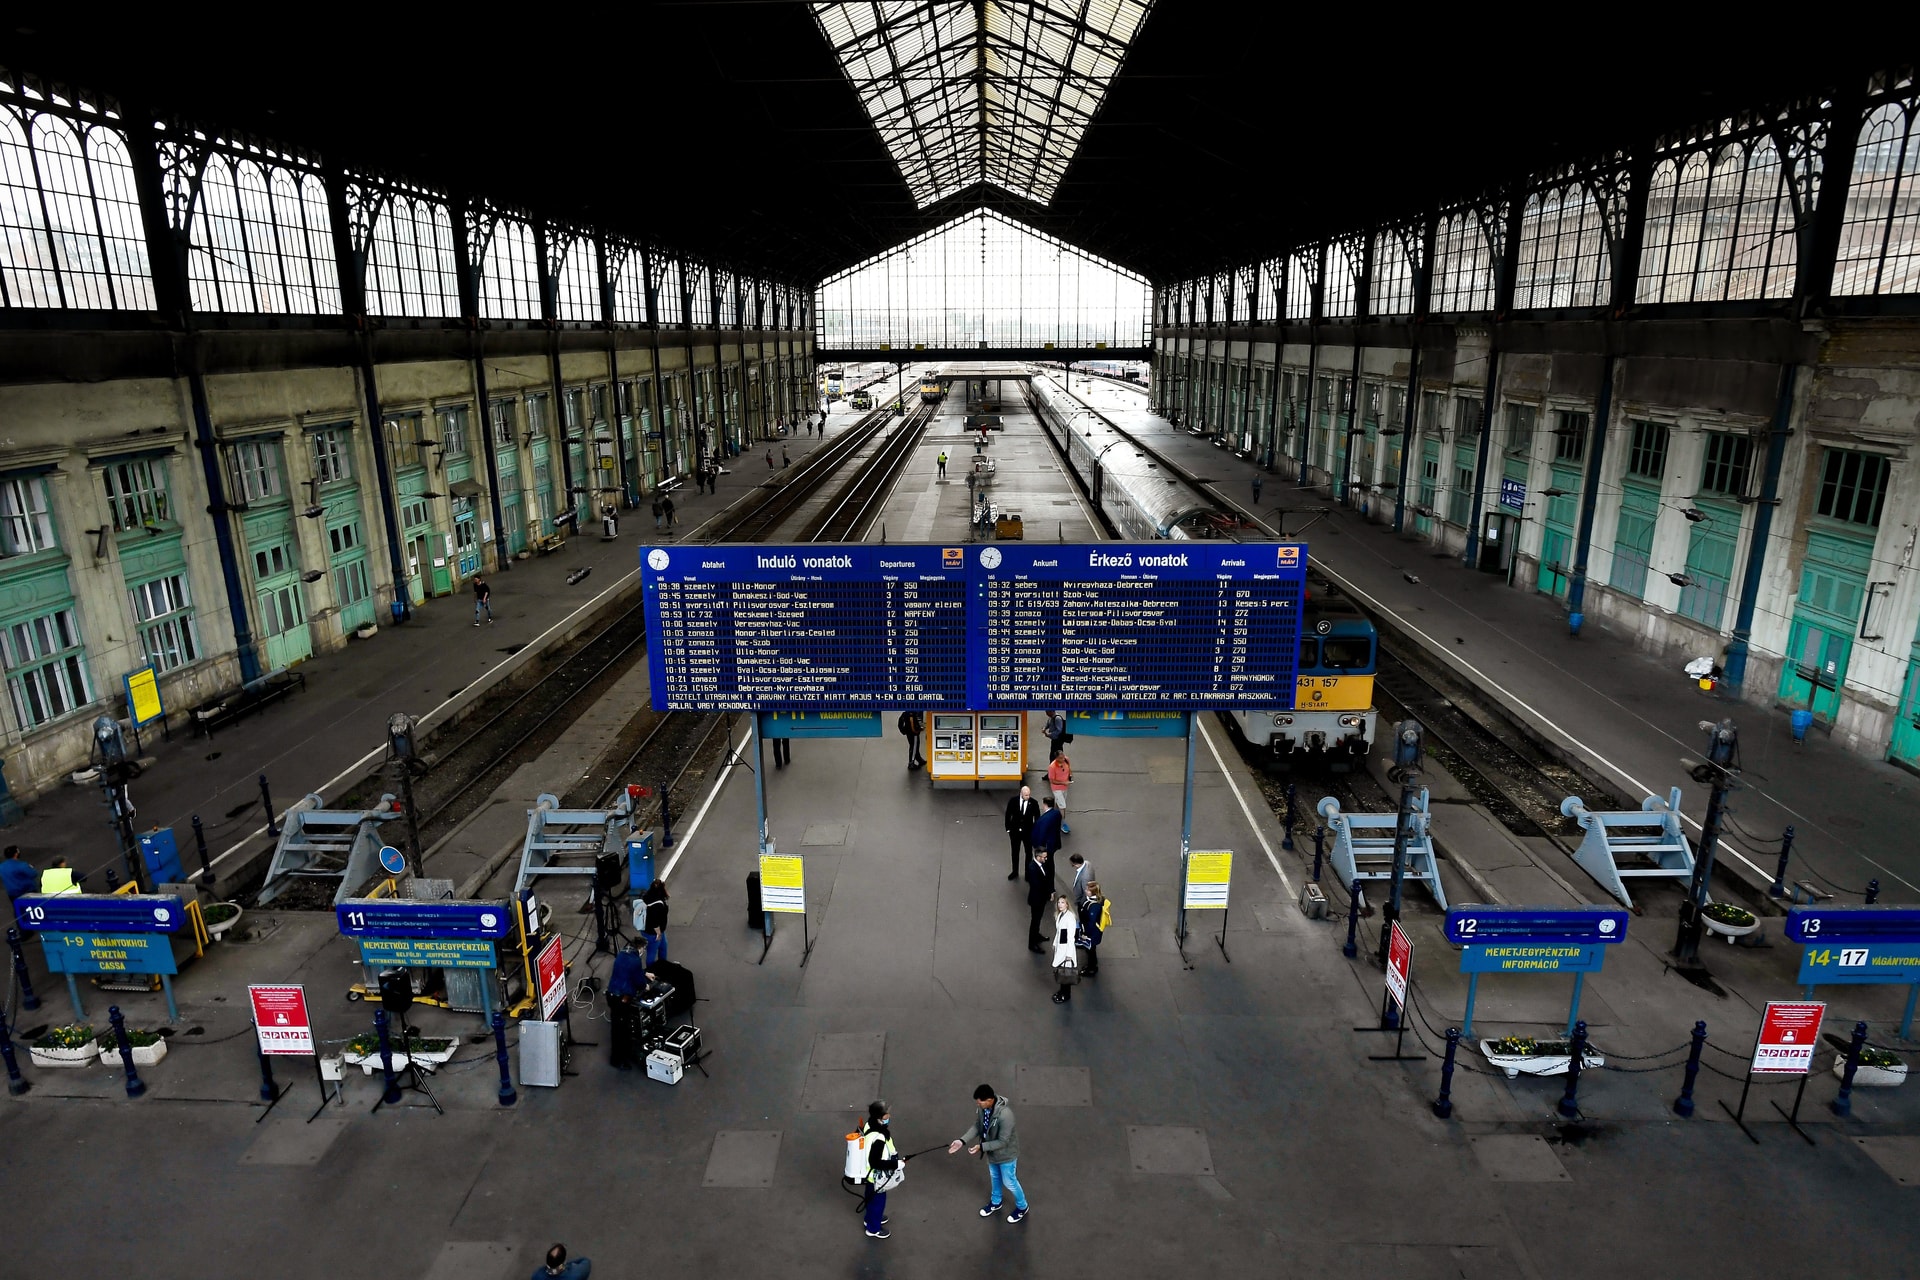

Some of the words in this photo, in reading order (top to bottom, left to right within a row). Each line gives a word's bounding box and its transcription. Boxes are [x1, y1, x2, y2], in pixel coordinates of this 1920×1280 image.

[702, 561, 725, 569] Abfahrt
[757, 555, 796, 569] Induló
[803, 555, 852, 568] vonatok
[1090, 550, 1132, 567] Érkező
[1139, 554, 1188, 567] vonatok
[1221, 559, 1245, 567] Arrivals
[1297, 679, 1314, 687] 431
[1322, 679, 1338, 687] 157
[26, 906, 44, 920] 10
[348, 912, 364, 925] 11
[1457, 919, 1477, 932] 12
[1802, 919, 1820, 932] 13
[63, 936, 84, 946] 1-9
[414, 942, 490, 951] MENETJEGYPÉNZTÁR
[91, 950, 127, 959] PÉNZTÁR
[1485, 947, 1580, 957] MENETJEGYPÉNZTÁR
[1808, 950, 1865, 966] 14-17
[99, 962, 126, 970] CASSA
[1502, 960, 1559, 969] INFORMÁCIÓ
